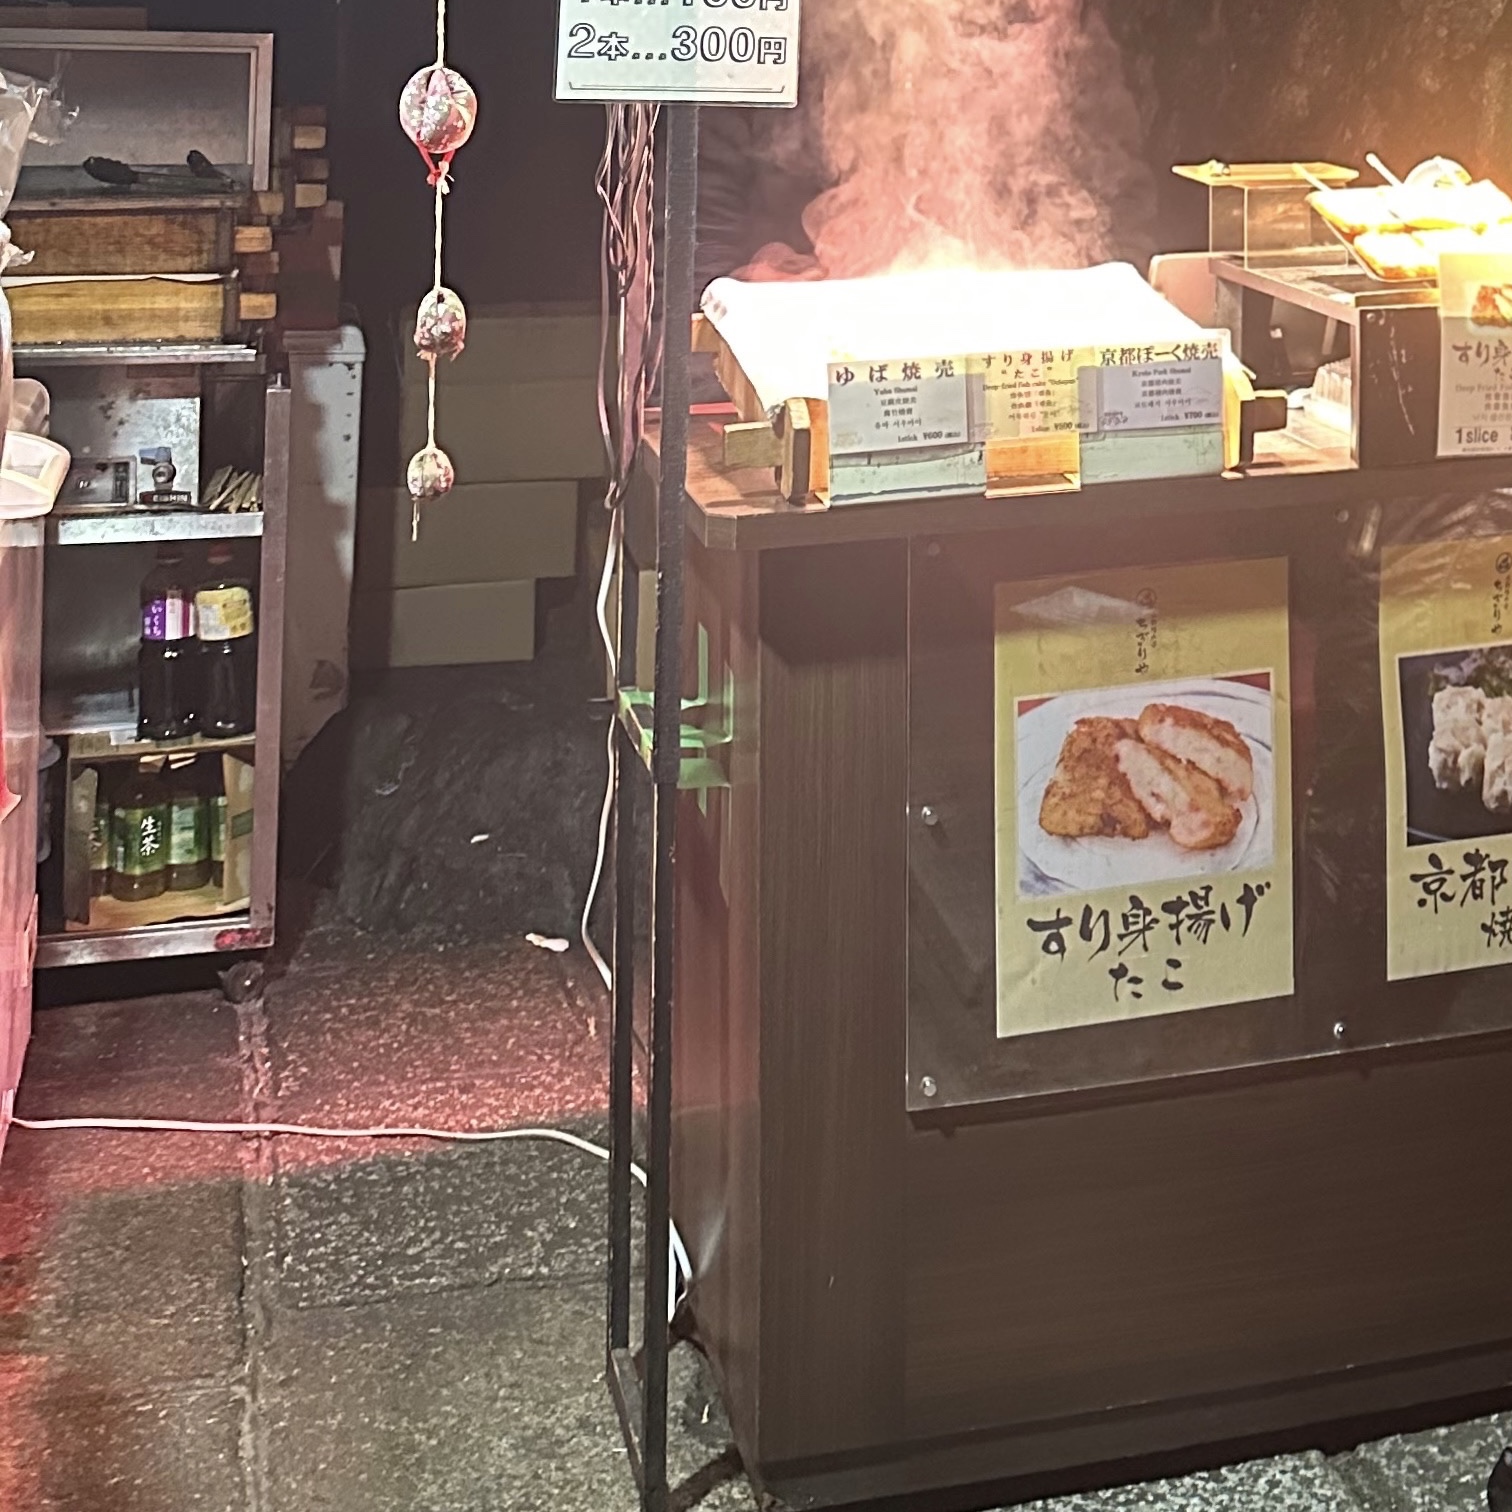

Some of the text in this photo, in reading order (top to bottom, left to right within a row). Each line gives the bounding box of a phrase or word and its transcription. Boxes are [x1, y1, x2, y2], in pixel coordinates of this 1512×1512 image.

[836, 359, 954, 386] ゆば焼売
[982, 349, 1074, 368] すり身揚げ
[1100, 342, 1219, 366] 京都ぽーく焼売
[1135, 618, 1149, 675] ちぎりや
[140, 815, 160, 856] 生茶
[1026, 881, 1272, 962] すり身揚げ
[1108, 957, 1184, 1003] たこ
